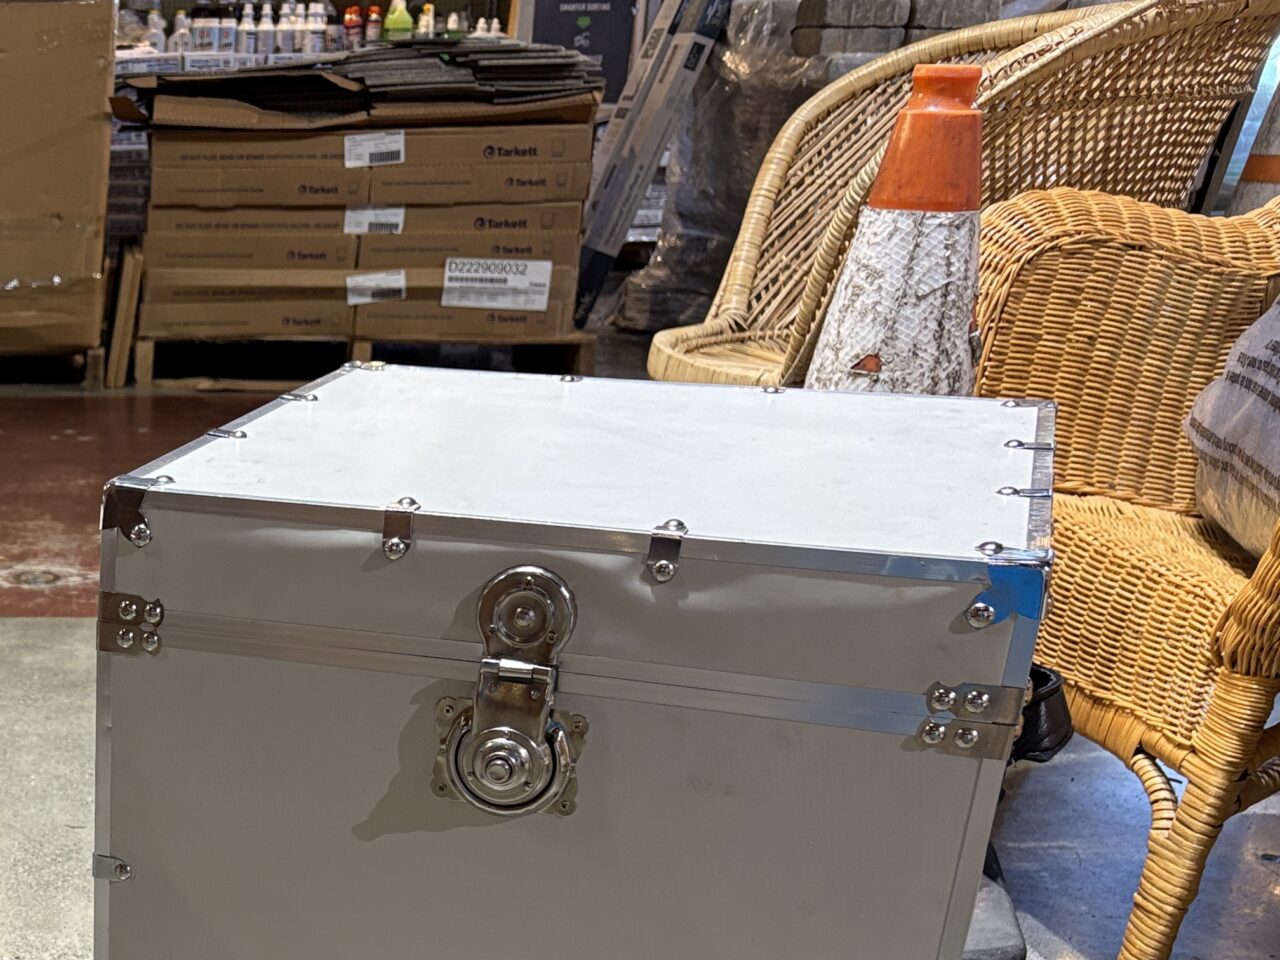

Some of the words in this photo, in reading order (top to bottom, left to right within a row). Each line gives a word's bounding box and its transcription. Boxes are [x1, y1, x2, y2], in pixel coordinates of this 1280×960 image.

[496, 146, 538, 157] Tarkett
[515, 178, 547, 187] Tarkett
[308, 185, 339, 194] Tarkett
[487, 218, 528, 229] Tarkett
